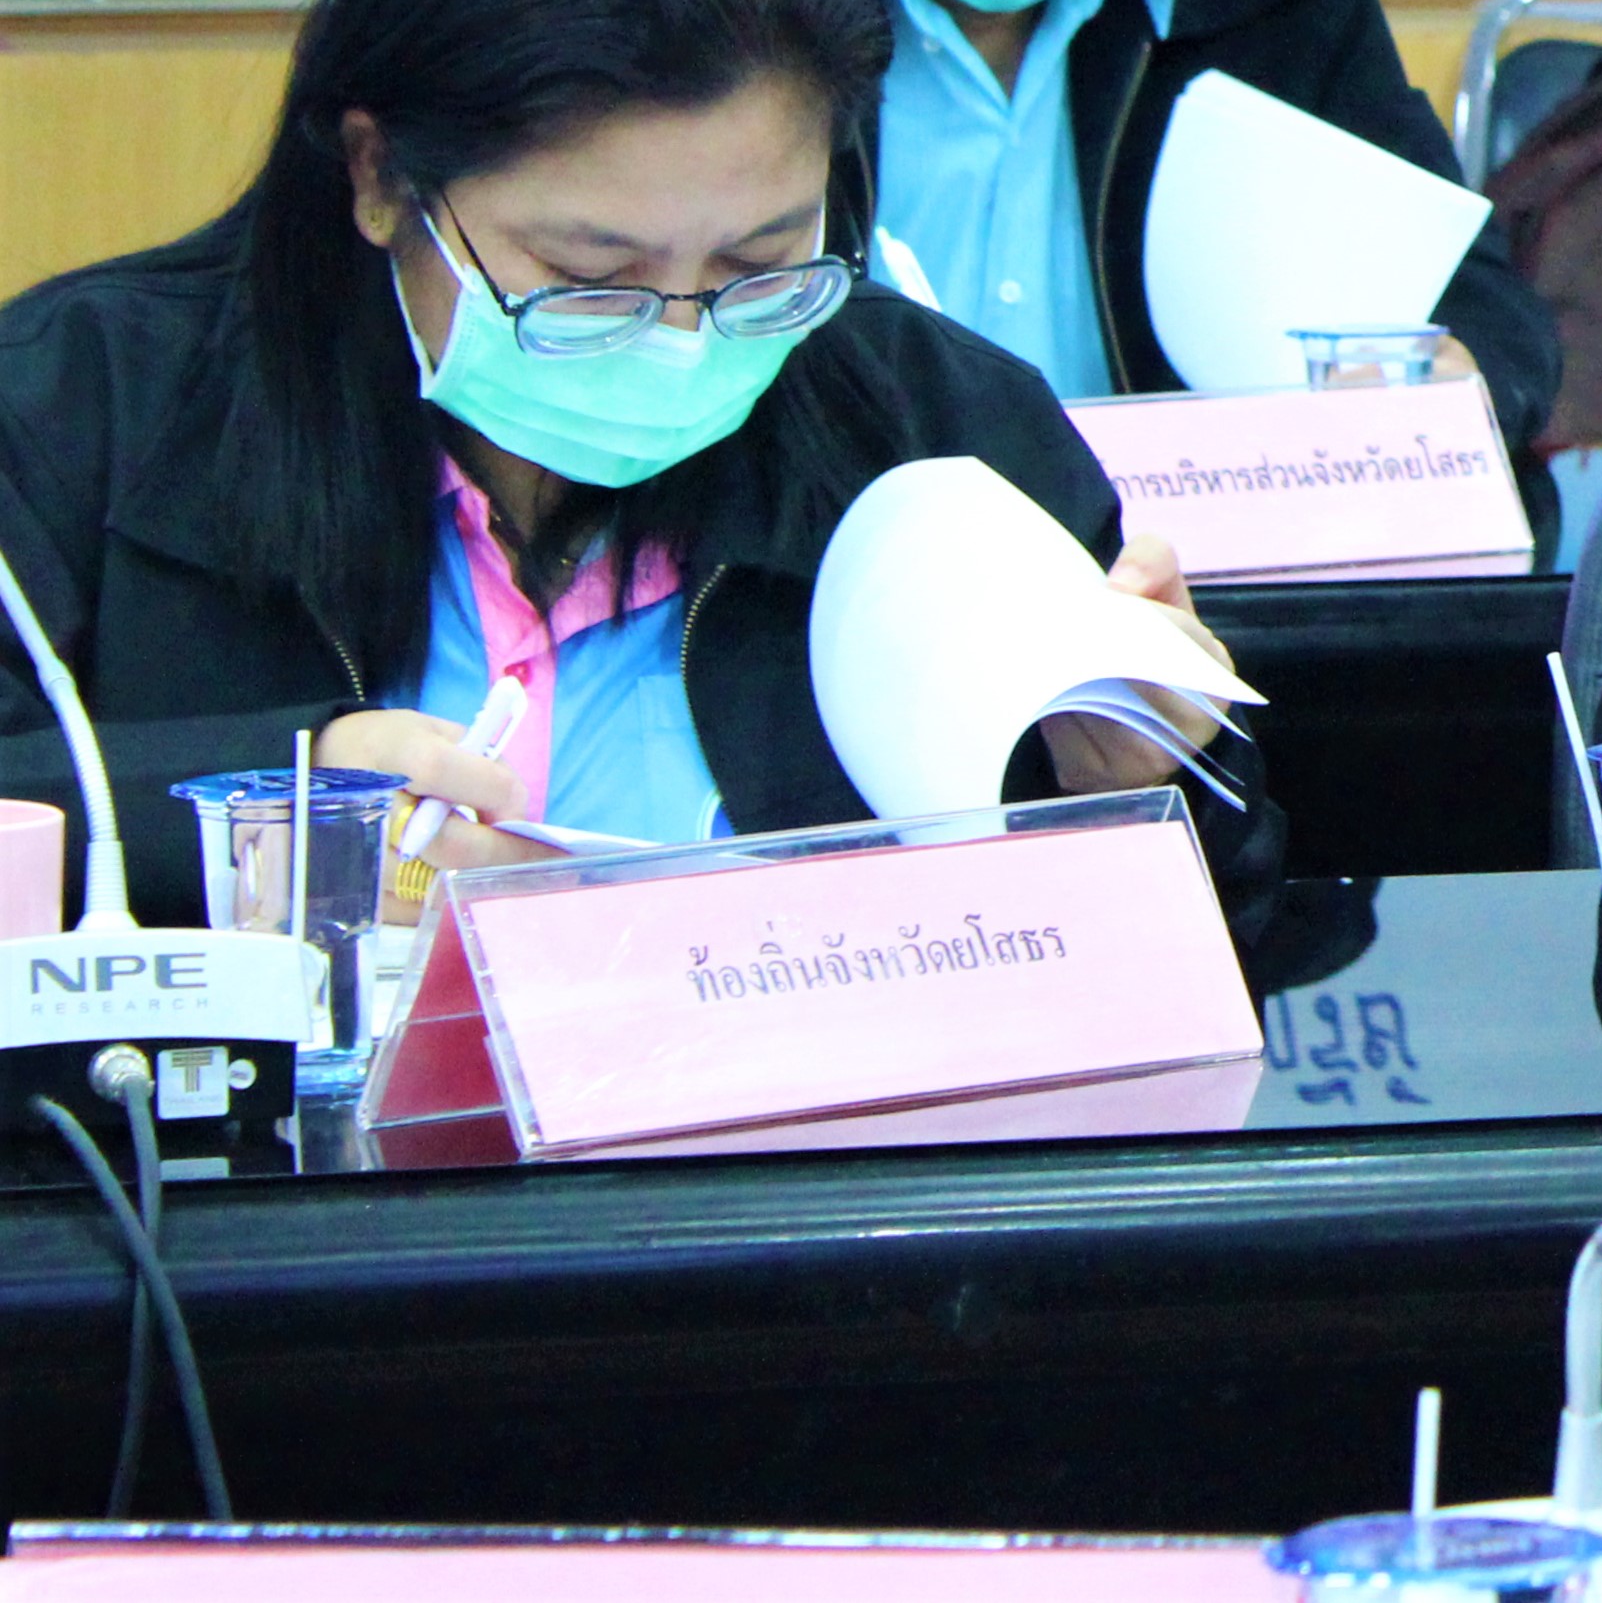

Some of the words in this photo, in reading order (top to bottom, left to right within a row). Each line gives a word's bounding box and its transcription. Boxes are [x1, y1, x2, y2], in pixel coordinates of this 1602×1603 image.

[1102, 435, 1490, 501] การบริหารส่วนจังหวัดยโสธร
[29, 952, 209, 994] NPE
[686, 913, 1068, 1003] ท้องถิ่นจังหวัดยโสธร
[30, 997, 210, 1016] RESEARCH
